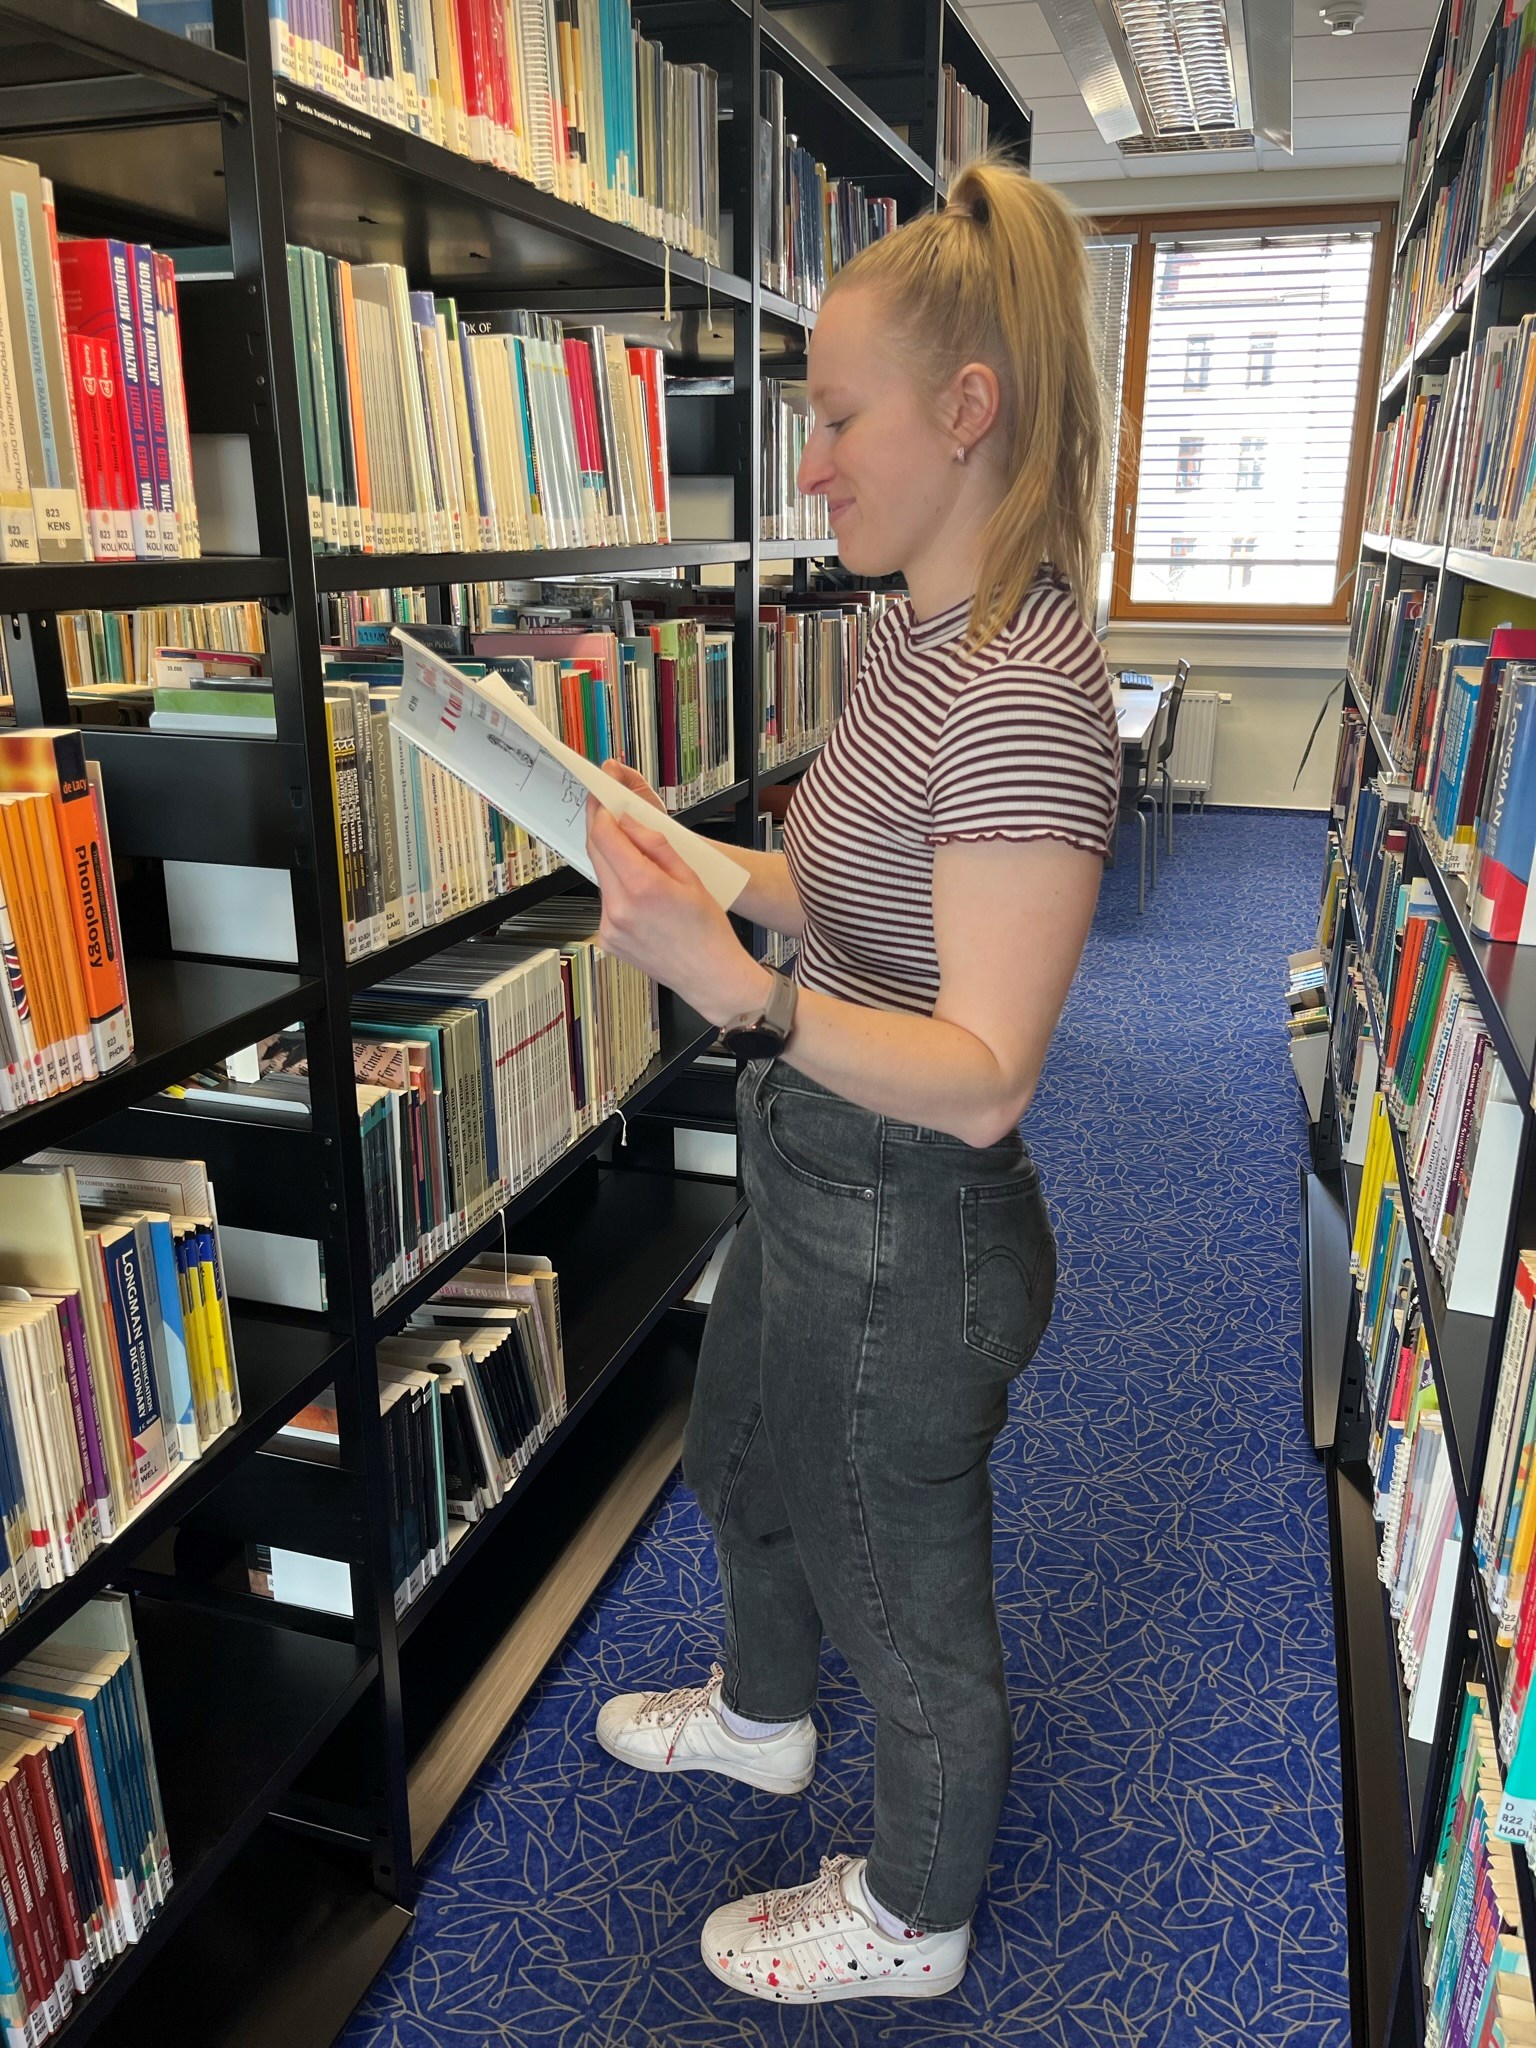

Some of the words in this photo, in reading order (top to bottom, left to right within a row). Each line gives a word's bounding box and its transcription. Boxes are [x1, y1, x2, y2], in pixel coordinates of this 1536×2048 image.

[15, 207, 32, 286] PHONOLOGY
[24, 287, 34, 302] IN
[113, 256, 132, 322] AKTIVÁTOR
[138, 261, 155, 326] AKTIVÁTOR
[26, 303, 43, 374] GENERATIVE
[480, 322, 492, 333] OF
[119, 324, 139, 384] JAZYKOVÝ
[143, 326, 161, 387] JAZYKOVÝ
[1, 339, 17, 437] PRONOUNCING
[35, 377, 51, 441] GRAMMAR
[127, 386, 145, 431] POUŽITÍ
[150, 388, 167, 434] POUŽITÍ
[136, 433, 146, 442] K
[158, 436, 167, 444] K
[136, 444, 150, 480] IHNED
[156, 446, 171, 481] IHNED
[8, 525, 21, 535] 823
[46, 508, 60, 518] 823
[47, 522, 71, 531] KENS
[10, 539, 30, 549] JONE
[99, 530, 111, 539] 823
[117, 530, 128, 539] 823
[145, 530, 156, 538] 823
[163, 531, 174, 540] 823
[357, 702, 365, 750] Cultures
[364, 702, 372, 763] Translating
[1493, 702, 1524, 829] LONGMAN
[63, 782, 72, 794] de
[72, 779, 87, 793] Lacy
[376, 723, 389, 802] LANGUAGE
[383, 812, 396, 880] RHETORIC
[342, 809, 350, 855] STYLISTICS
[349, 807, 357, 853] STYLISTICS
[356, 805, 364, 851] STYLISTICS
[404, 814, 413, 871] Translation
[434, 807, 442, 844] ANGLICKÉ
[386, 912, 395, 920] 824
[386, 919, 401, 930] LANG
[408, 919, 420, 928] LARS
[1447, 992, 1460, 1024] TESTS
[107, 1036, 117, 1048] 823
[1444, 1025, 1452, 1041] IN
[108, 1044, 125, 1060] PHON
[1430, 1042, 1448, 1098] ENGLISH
[453, 1125, 459, 1136] to
[460, 1114, 465, 1125] to
[1427, 1140, 1439, 1173] Daniel
[455, 1163, 463, 1188] From
[121, 1247, 144, 1343] LONGMAN
[129, 1346, 147, 1419] DICTIONARY
[138, 1340, 155, 1412] PRONUNCIATION
[80, 1435, 88, 1451] BEZ
[140, 1461, 151, 1475] 823
[141, 1465, 159, 1483] WELL
[0, 1583, 12, 1599] 823
[1502, 1815, 1523, 1826] 822
[1505, 1801, 1514, 1811] D
[47, 1789, 59, 1825] Teaching
[54, 1823, 69, 1875] LISTENING
[2, 1797, 10, 1817] Tips
[17, 1861, 34, 1914] LISTENING
[30, 1847, 47, 1898] LISTENING
[1, 1875, 19, 1927] LISTENING
[1473, 1946, 1483, 1974] Teach
[1476, 1963, 1487, 1992] Teach
[1460, 1977, 1475, 2029] Vocabulary
[1463, 1997, 1479, 2047] Vocabulary
